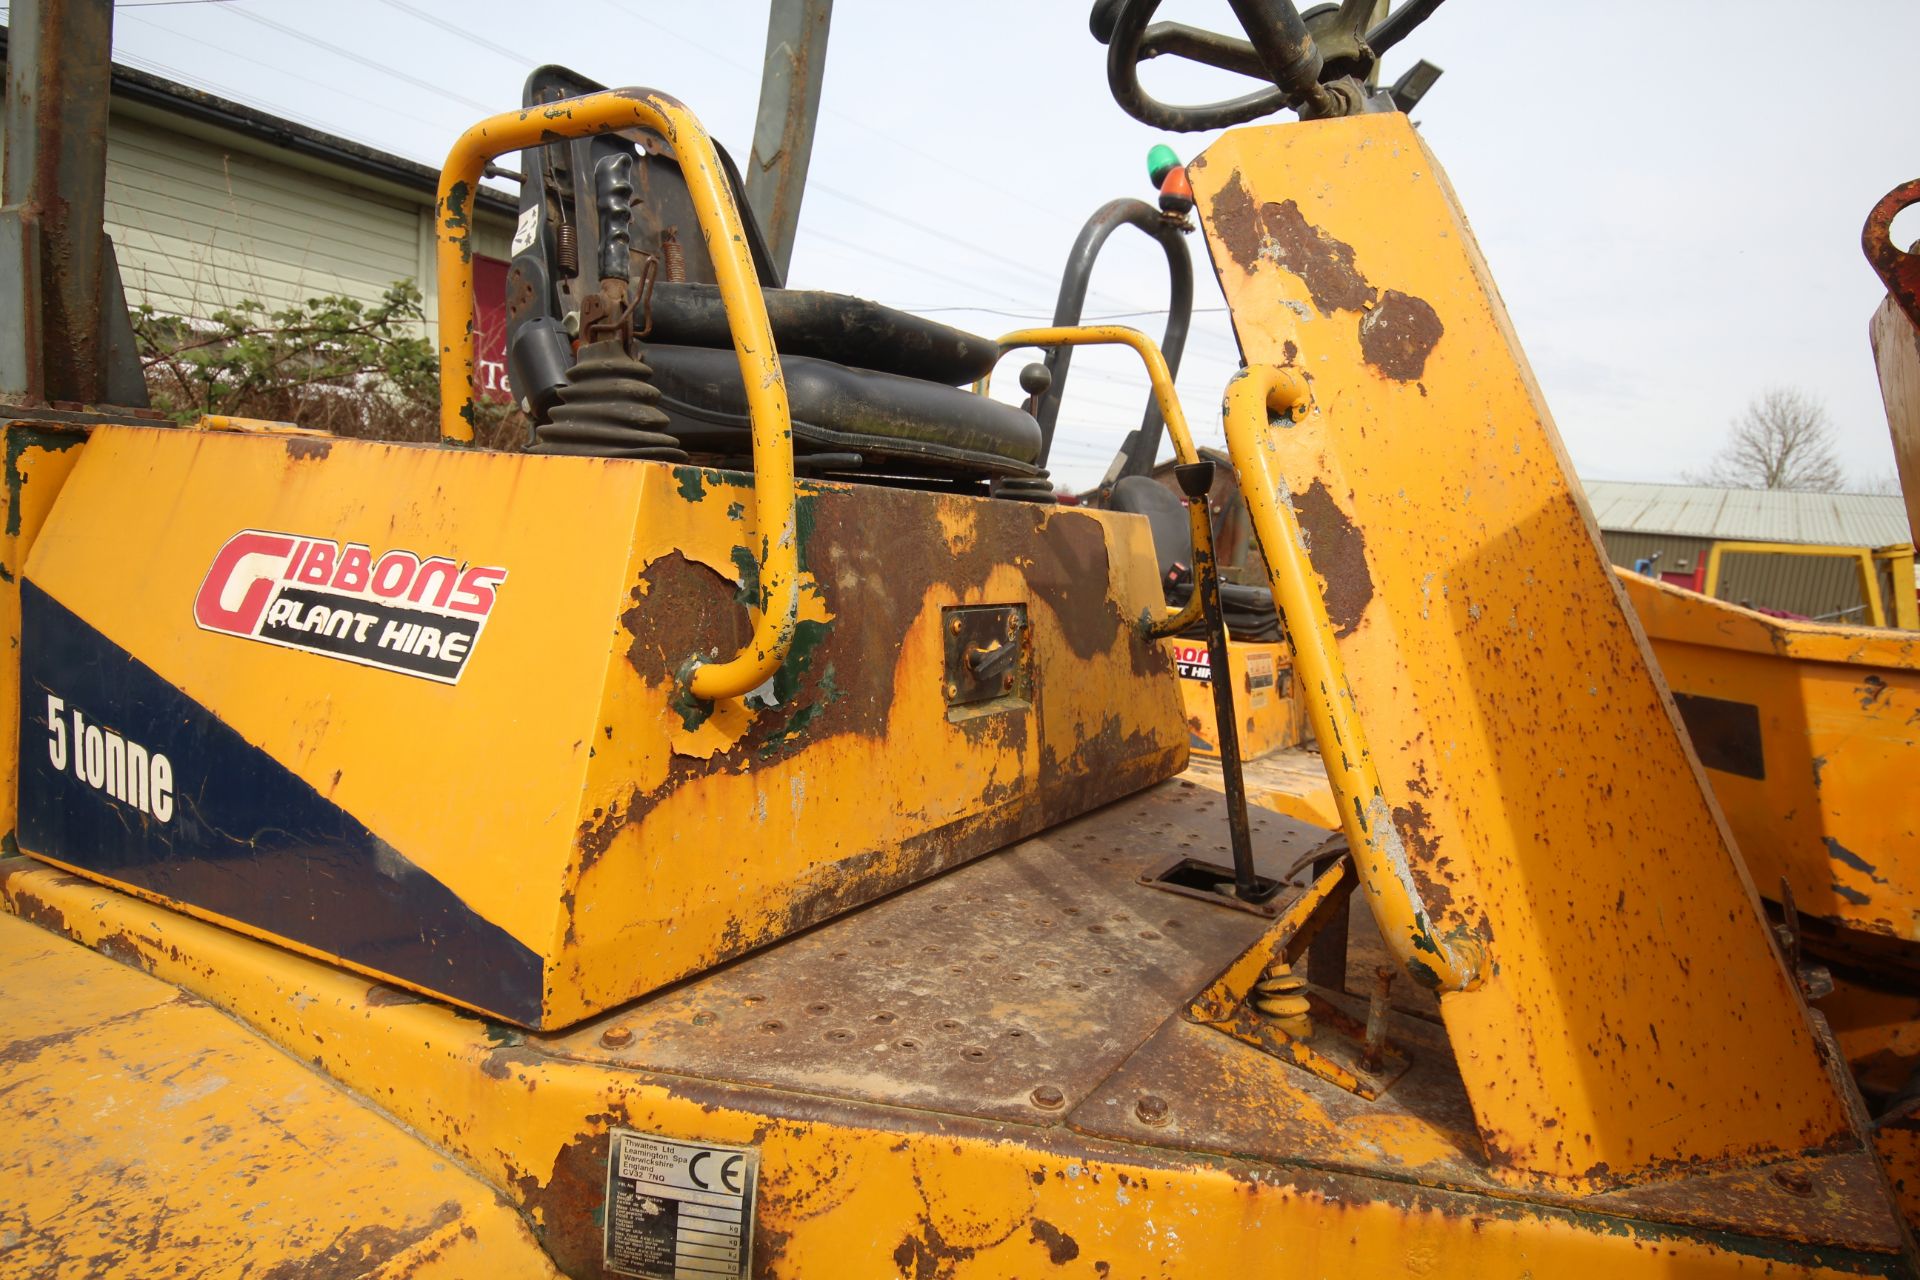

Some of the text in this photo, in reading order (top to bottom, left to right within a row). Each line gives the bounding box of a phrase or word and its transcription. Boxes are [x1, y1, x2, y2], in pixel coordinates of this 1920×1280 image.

[267, 598, 471, 663] PLANT HIRE
[48, 694, 173, 823] 5 tonne
[625, 1138, 675, 1154] Thwaites Ltd
[623, 1154, 674, 1169] Warwickshire
[624, 1146, 688, 1163] Leamington Spa
[622, 1168, 643, 1178] CV32
[623, 1161, 654, 1173] England
[688, 1151, 743, 1194] CE
[729, 1225, 739, 1233] kg
